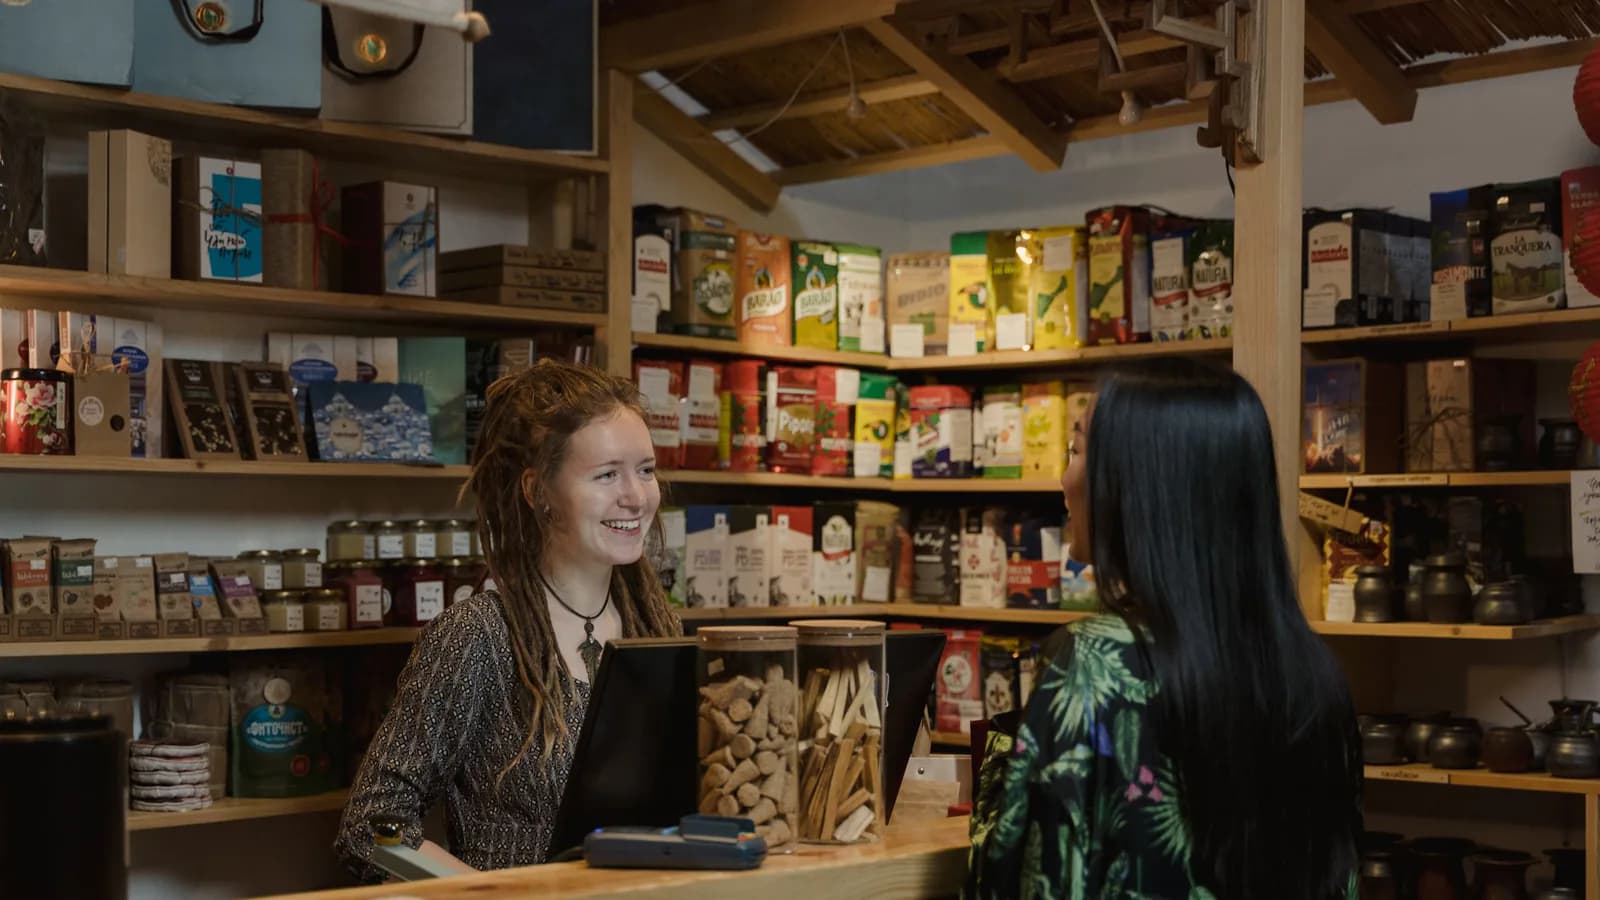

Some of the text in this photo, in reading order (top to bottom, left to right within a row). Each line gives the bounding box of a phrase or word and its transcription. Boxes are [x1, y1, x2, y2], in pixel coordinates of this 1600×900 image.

[1514, 235, 1525, 243] LA
[1493, 241, 1552, 256] TRANQUERA
[1154, 275, 1185, 290] NATURA
[1195, 267, 1228, 283] NATURA
